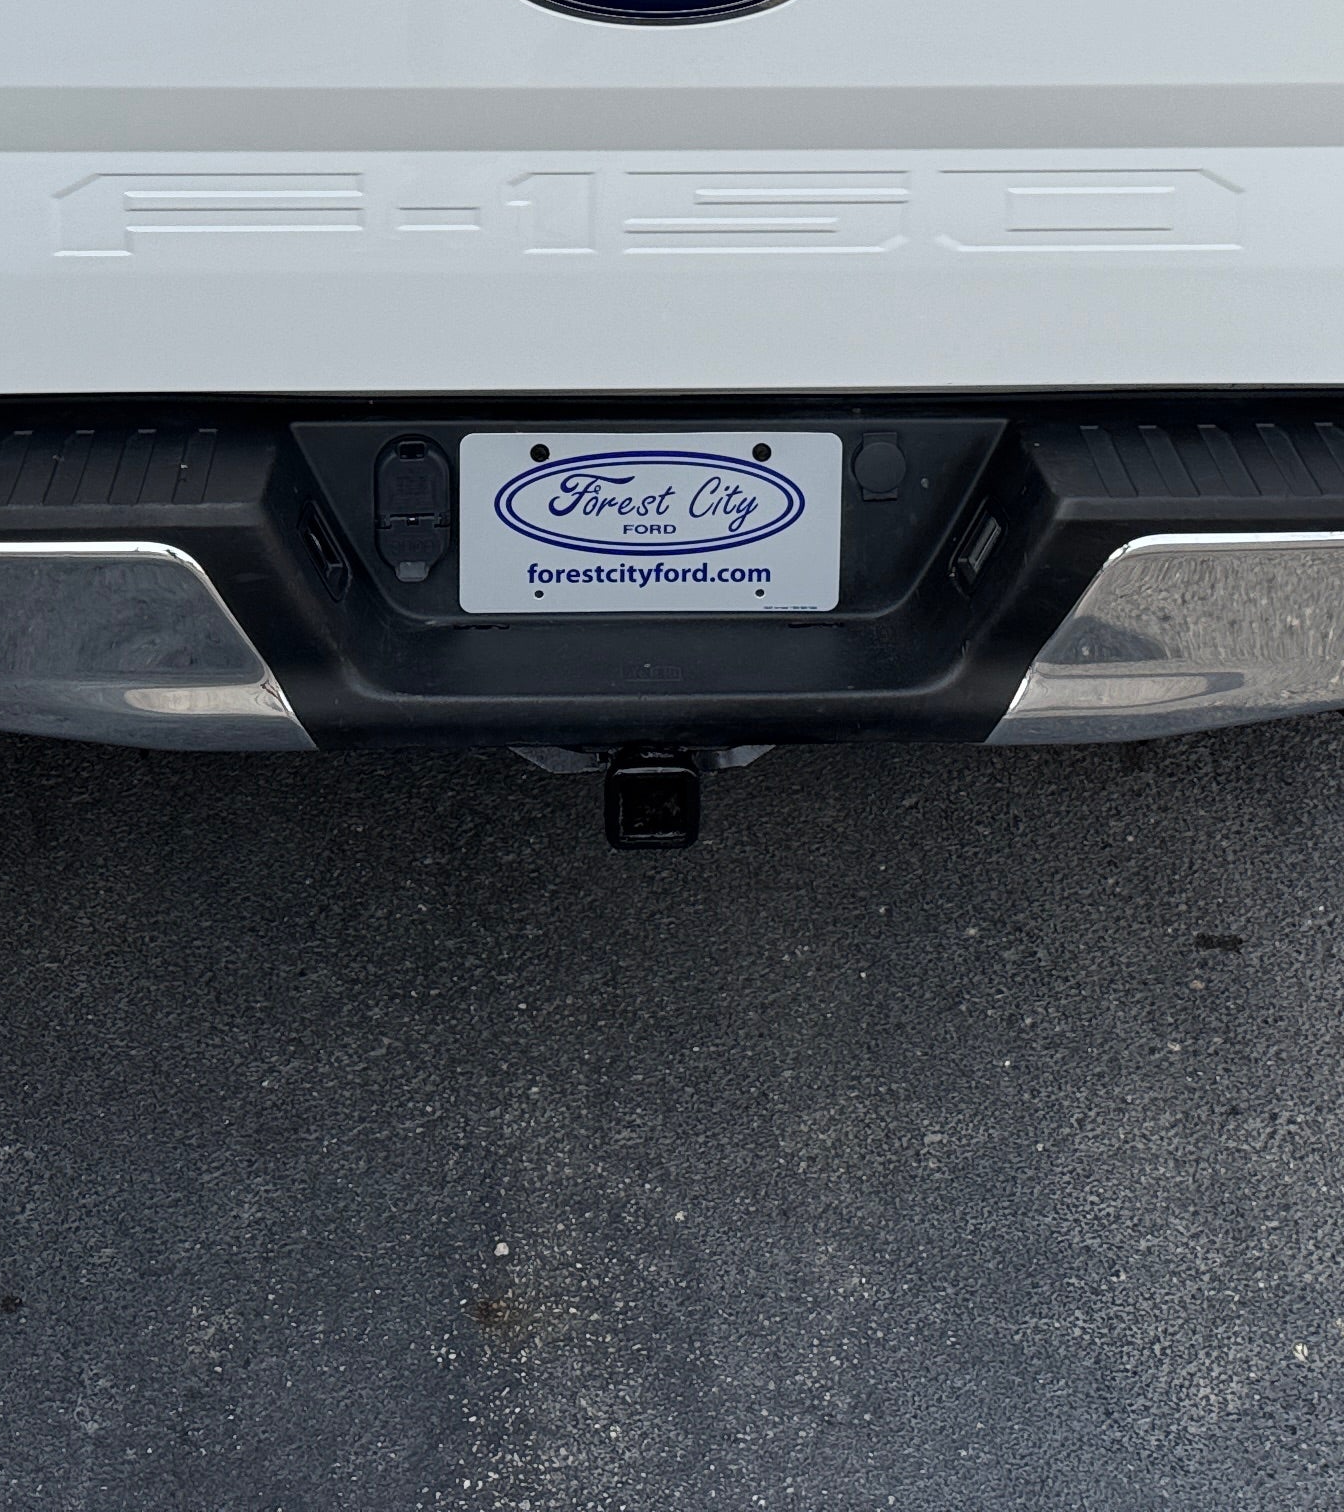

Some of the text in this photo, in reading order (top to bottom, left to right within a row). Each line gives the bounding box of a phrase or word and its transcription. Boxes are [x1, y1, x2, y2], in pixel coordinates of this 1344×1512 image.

[52, 167, 1246, 257] F-150
[548, 473, 758, 533] Forest City
[622, 523, 677, 535] FORD
[527, 562, 771, 588] forestcityford.com
